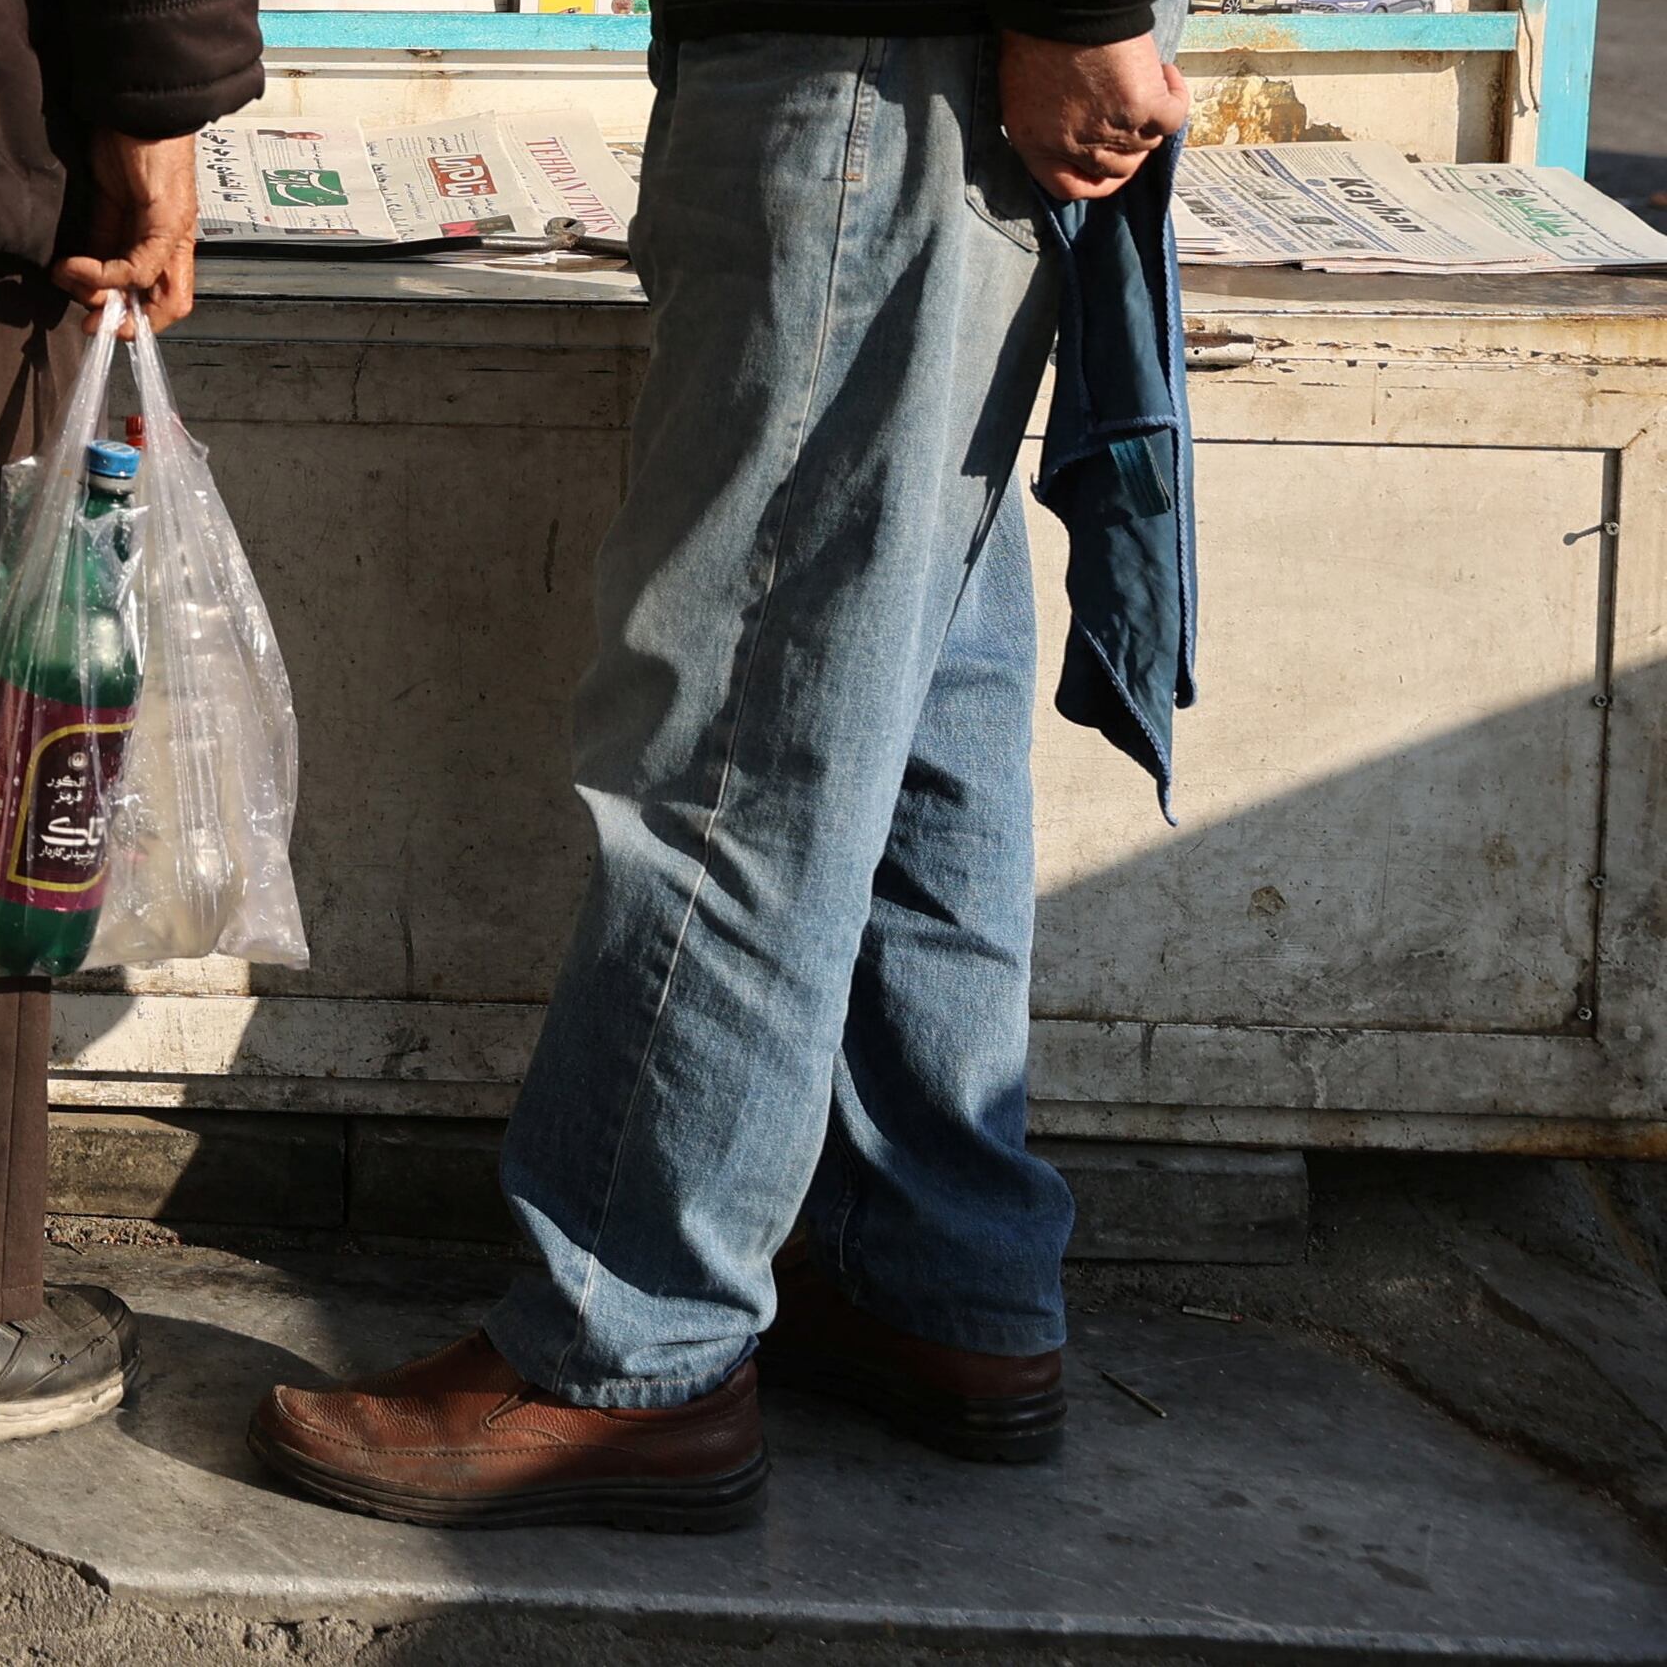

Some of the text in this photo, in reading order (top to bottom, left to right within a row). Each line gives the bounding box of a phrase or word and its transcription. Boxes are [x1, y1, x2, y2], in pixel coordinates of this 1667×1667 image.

[525, 136, 624, 235] TEHRAN TIMES
[1329, 177, 1428, 234] Kayhan
[46, 775, 86, 788] انگور
[54, 790, 83, 804] قرمز
